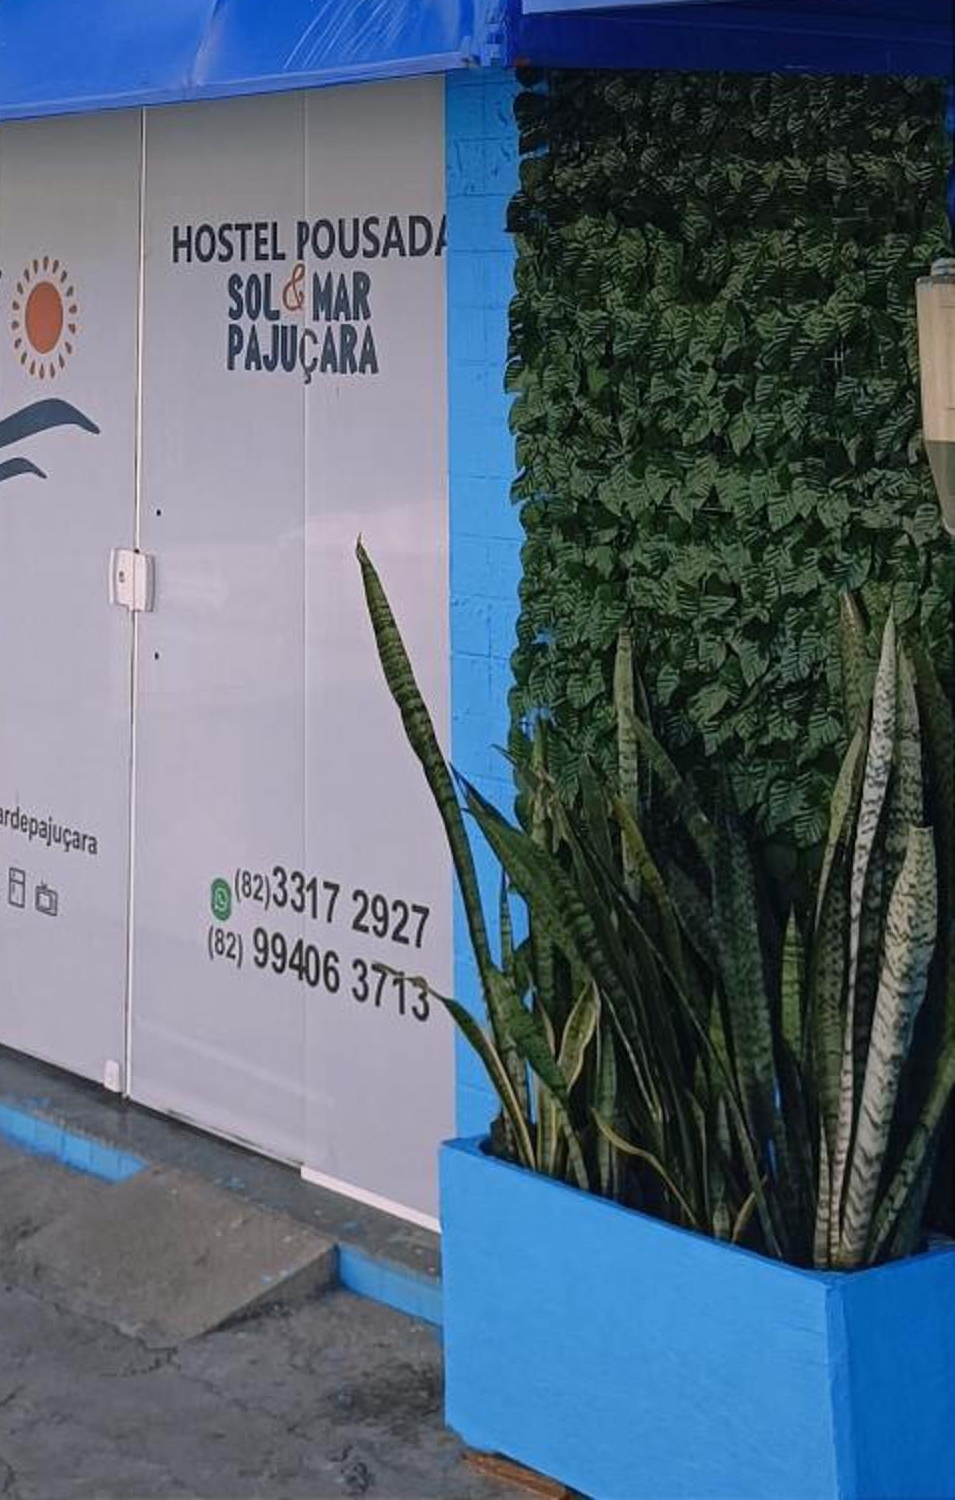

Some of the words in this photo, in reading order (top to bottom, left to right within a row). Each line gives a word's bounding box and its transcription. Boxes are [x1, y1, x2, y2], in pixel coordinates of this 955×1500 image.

[172, 221, 286, 263] HOSTEL
[227, 272, 281, 321] SOL
[282, 263, 305, 312] &
[312, 271, 372, 322] MAR
[226, 324, 379, 385] PAJUÇARA
[351, 889, 430, 949] 2927
[208, 925, 244, 969] (82)
[253, 927, 340, 994] 99406
[351, 958, 430, 1022] 3713
